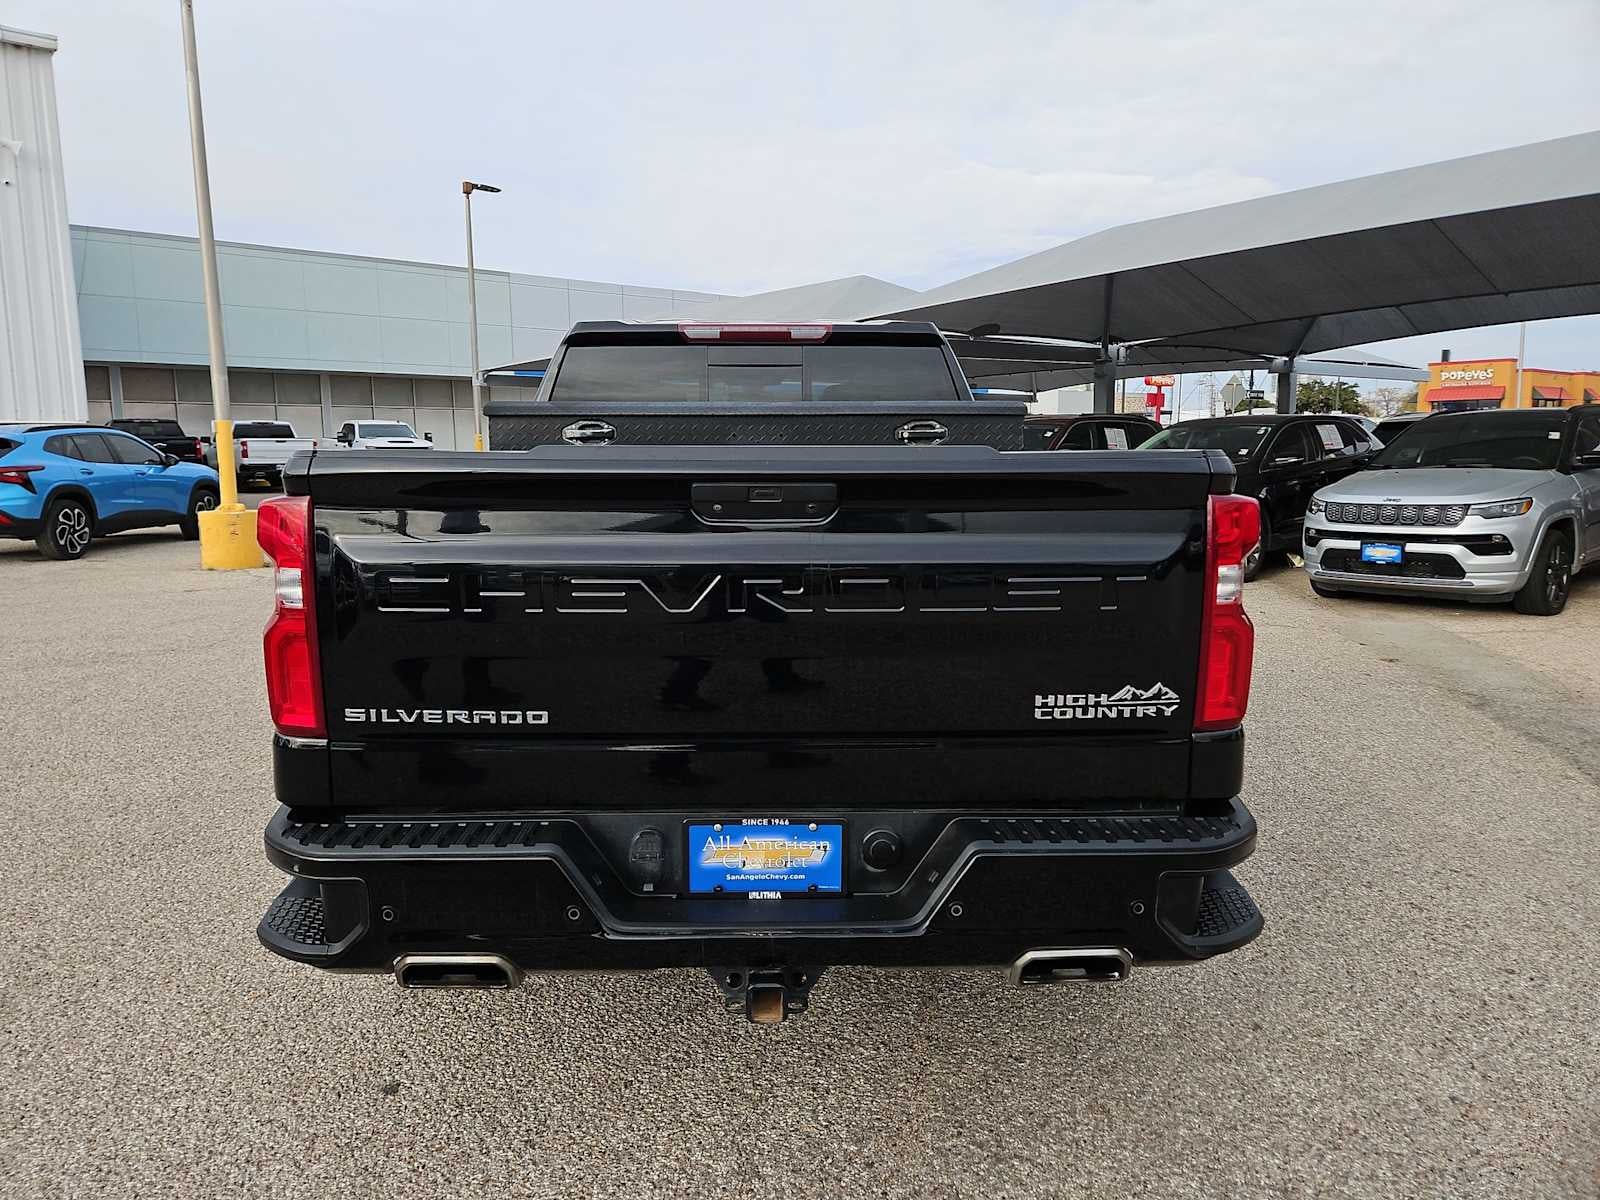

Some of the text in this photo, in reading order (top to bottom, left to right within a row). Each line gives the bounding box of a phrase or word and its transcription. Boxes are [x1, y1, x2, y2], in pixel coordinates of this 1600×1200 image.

[1441, 368, 1494, 380] POPEYES
[377, 575, 1147, 613] CHEVROLET
[1034, 694, 1108, 706] HIGH
[344, 708, 550, 725] SILVERADO
[1034, 705, 1179, 720] COUNTRY
[742, 818, 769, 826] SINCE
[703, 835, 830, 851] All American
[722, 851, 809, 868] Chevrolet
[726, 873, 806, 881] SanAngeloChevy.com
